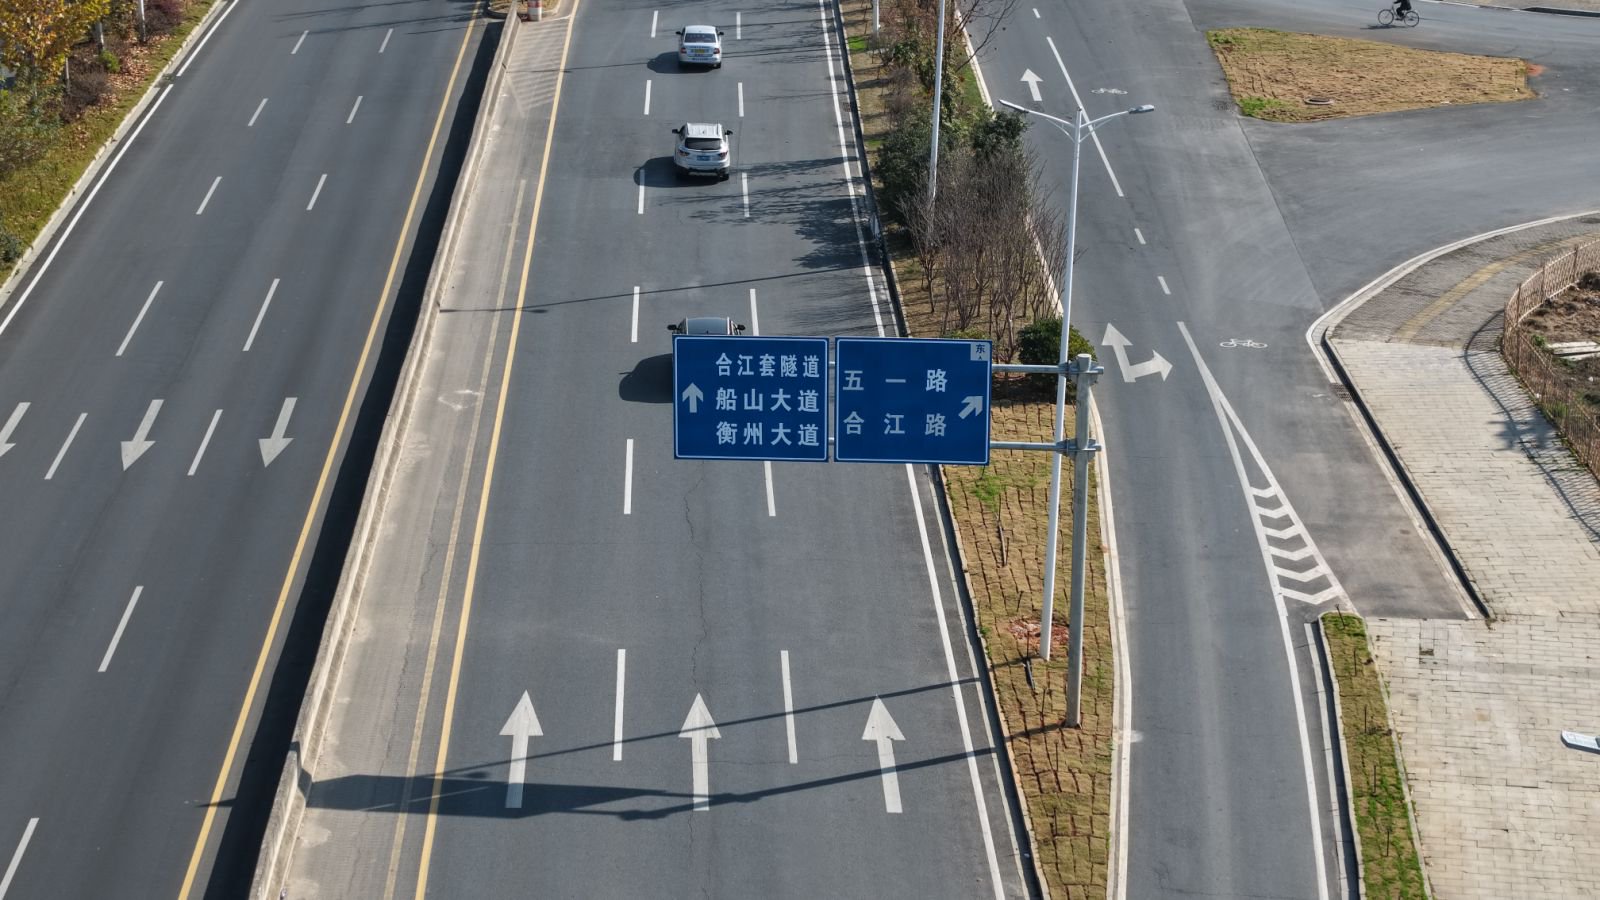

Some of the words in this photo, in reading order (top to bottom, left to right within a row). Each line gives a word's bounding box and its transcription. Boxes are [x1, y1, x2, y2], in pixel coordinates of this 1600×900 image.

[975, 344, 986, 354] 东
[715, 352, 820, 378] 合江套隧道
[842, 369, 948, 392] 五一路
[715, 387, 820, 412] 船山大道
[715, 421, 820, 446] 衡州大道
[843, 412, 947, 436] 合江路
